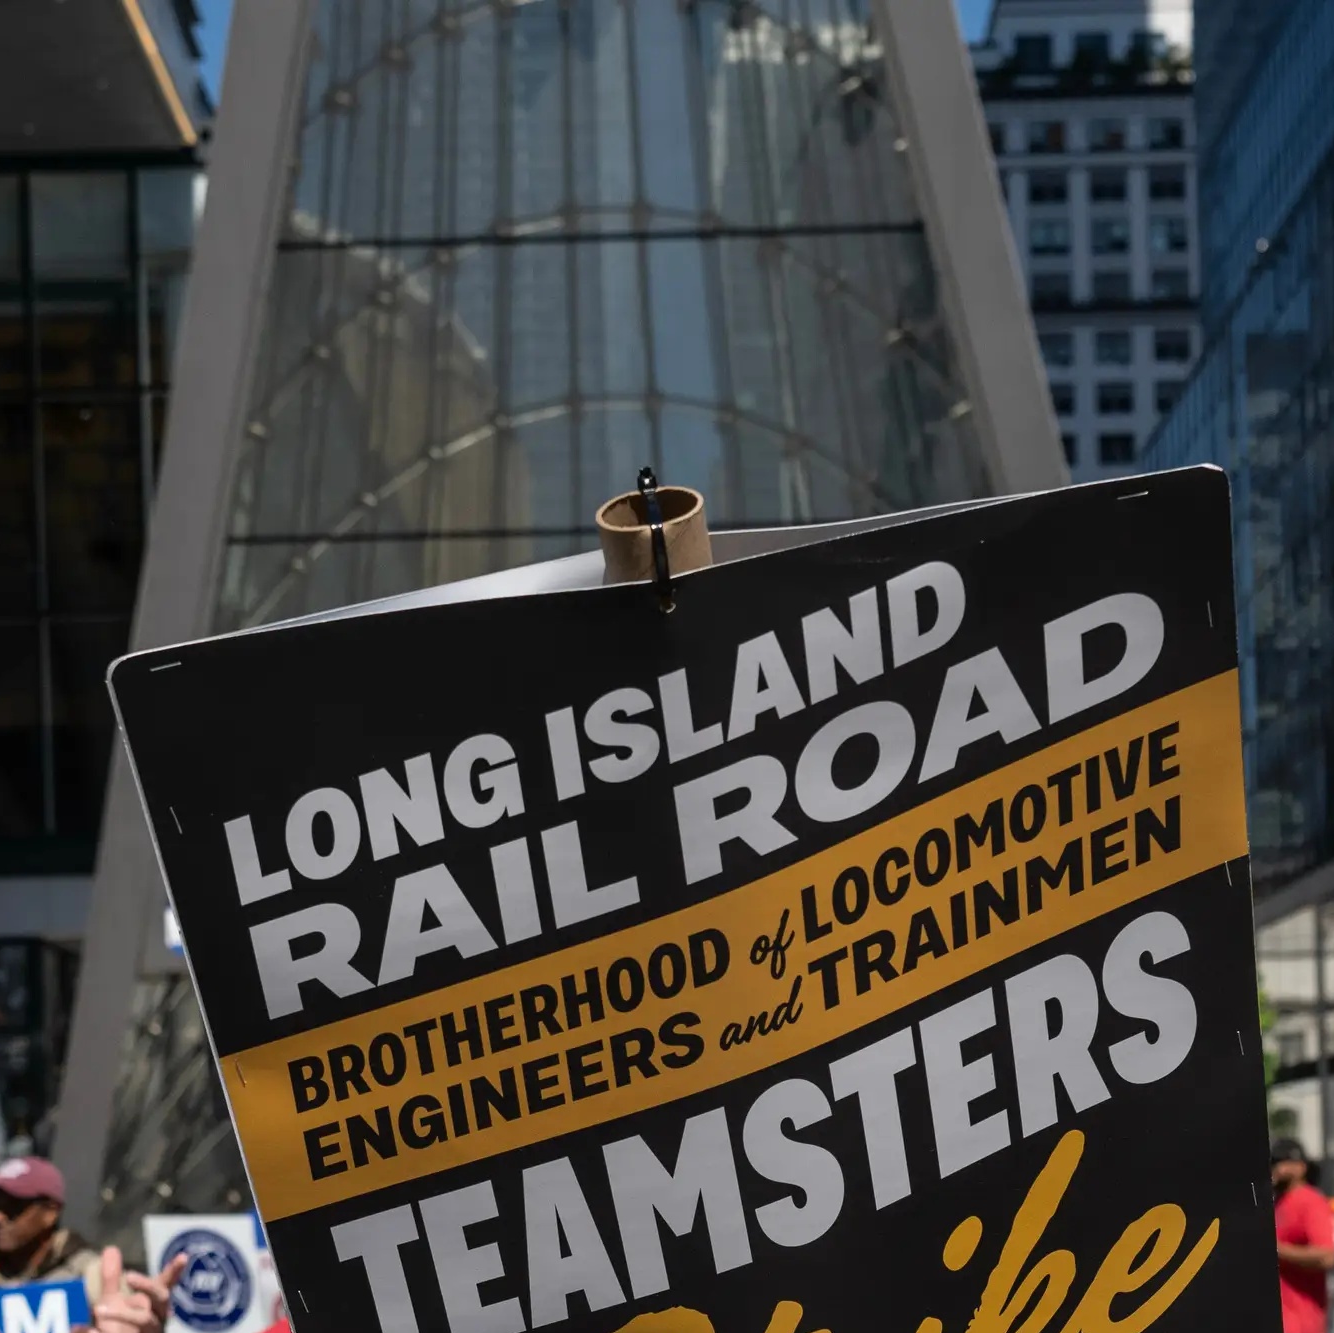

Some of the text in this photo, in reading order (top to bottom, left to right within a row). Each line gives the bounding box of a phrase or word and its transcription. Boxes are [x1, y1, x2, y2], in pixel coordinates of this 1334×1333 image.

[224, 562, 965, 905] LONG ISLAND
[249, 593, 1164, 1019] RAIL ROAD
[288, 722, 1181, 1113] BROTHERHOOD of LOCOMOTIVE
[304, 795, 1180, 1181] ENGINEERS and TRAINMEN
